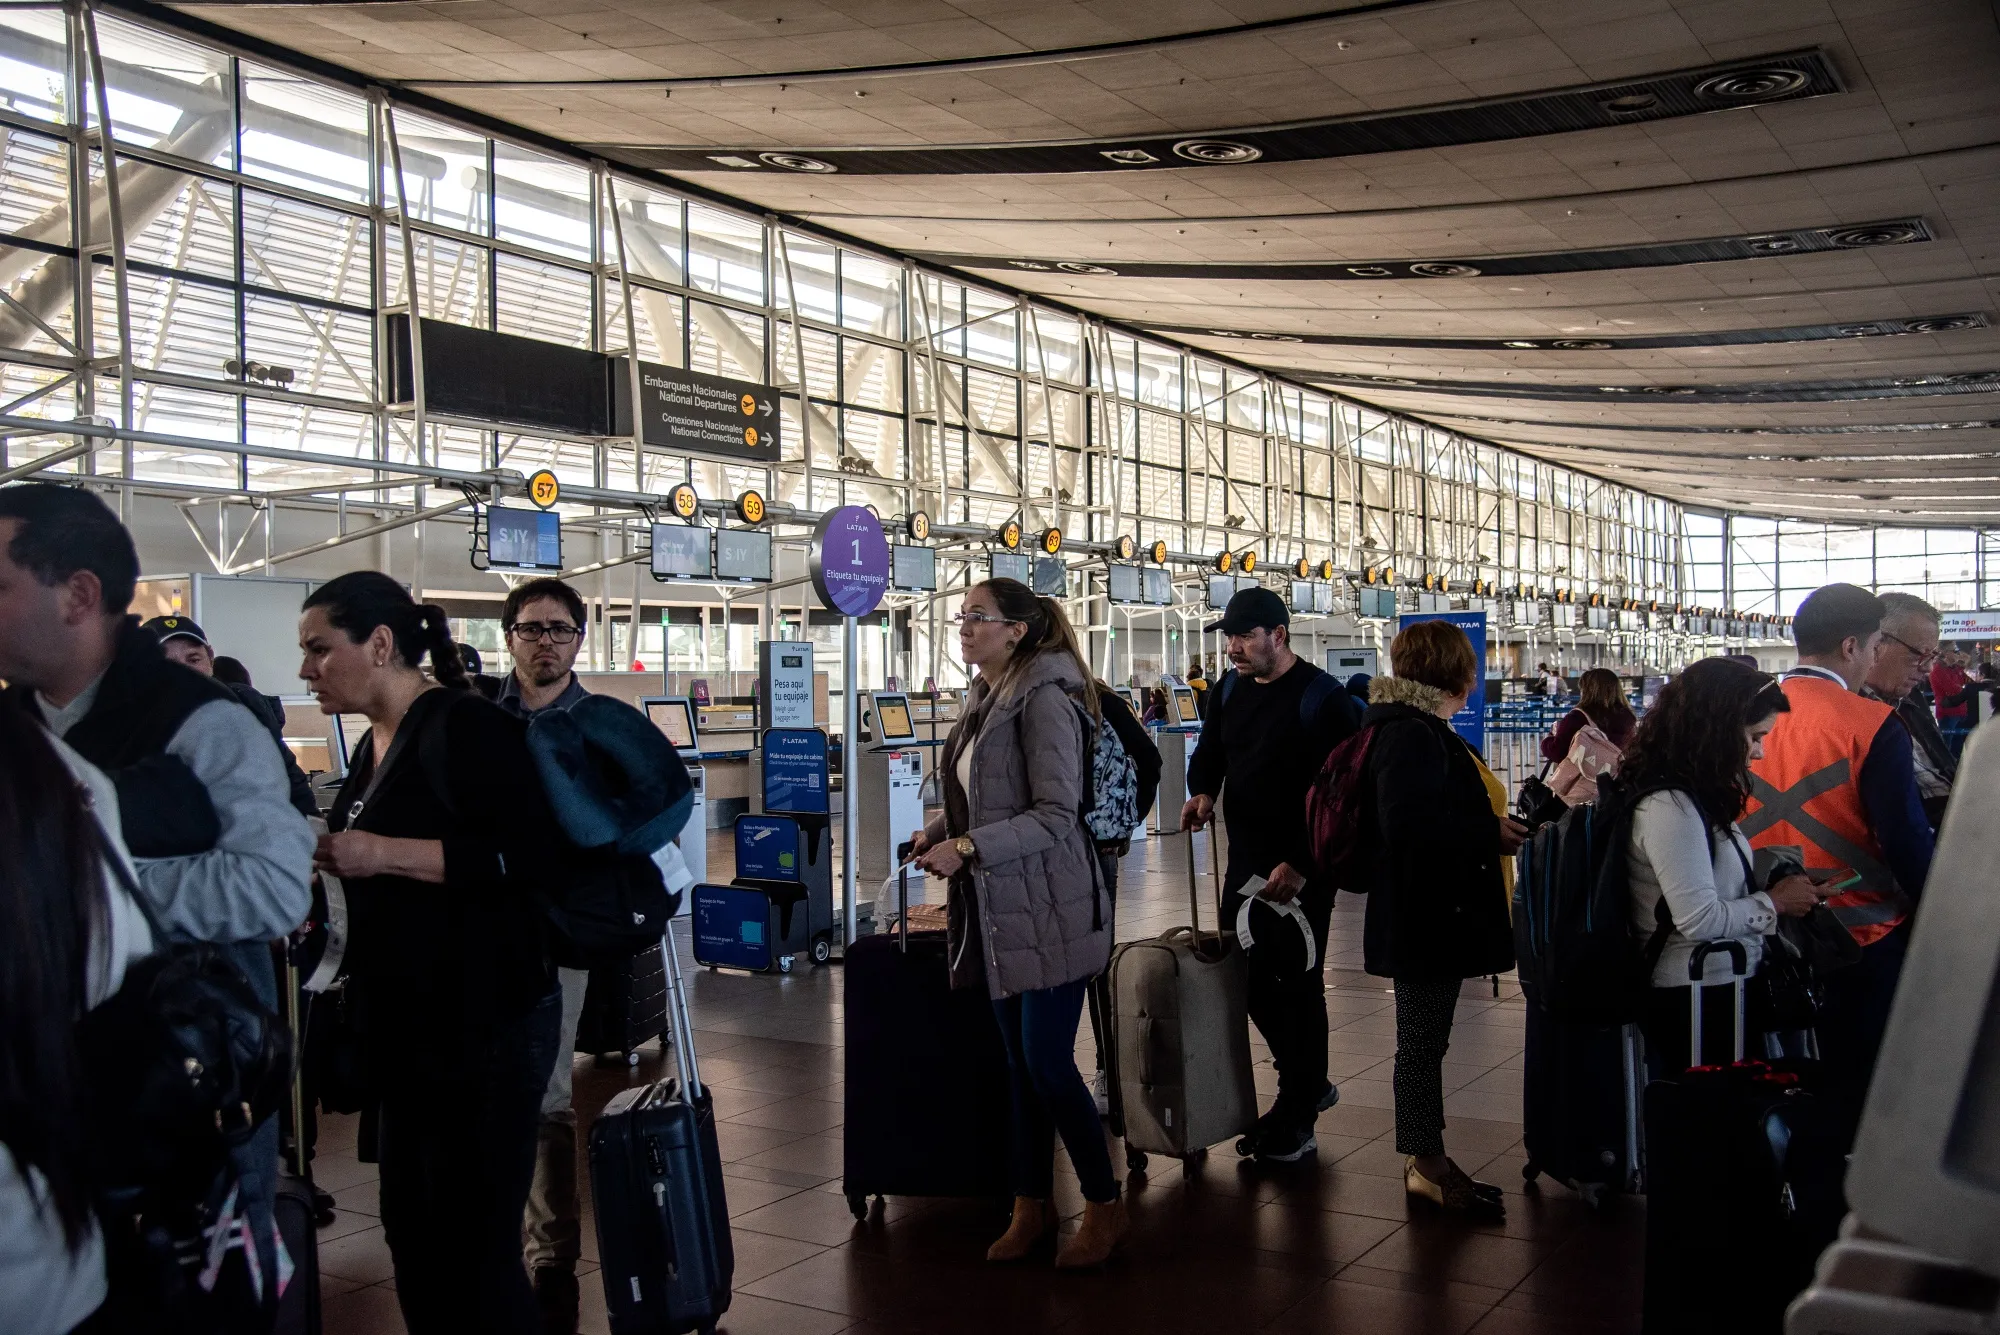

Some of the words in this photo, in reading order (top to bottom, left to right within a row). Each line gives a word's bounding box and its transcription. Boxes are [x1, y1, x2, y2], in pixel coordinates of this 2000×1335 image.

[644, 374, 691, 393] Embarques
[692, 383, 737, 401] Nacionales
[659, 390, 693, 406] National
[694, 397, 738, 414] Departures
[662, 412, 704, 428] Conexiones
[704, 419, 744, 435] Nacionales
[671, 425, 700, 438] National
[701, 429, 744, 445] Connections
[536, 482, 554, 498] 57
[678, 493, 694, 509] 58
[746, 500, 761, 515] 59
[846, 523, 869, 533] LATAM
[916, 519, 926, 532] 61
[1008, 529, 1018, 541] 62
[1048, 535, 1059, 547] 63
[851, 538, 863, 566] 1
[826, 569, 852, 582] Etiqueta
[853, 572, 860, 581] tu
[860, 573, 885, 585] equipaje
[774, 679, 790, 689] Pesa
[790, 679, 804, 691] aquí
[774, 692, 782, 701] tu
[783, 690, 809, 703] equipaje
